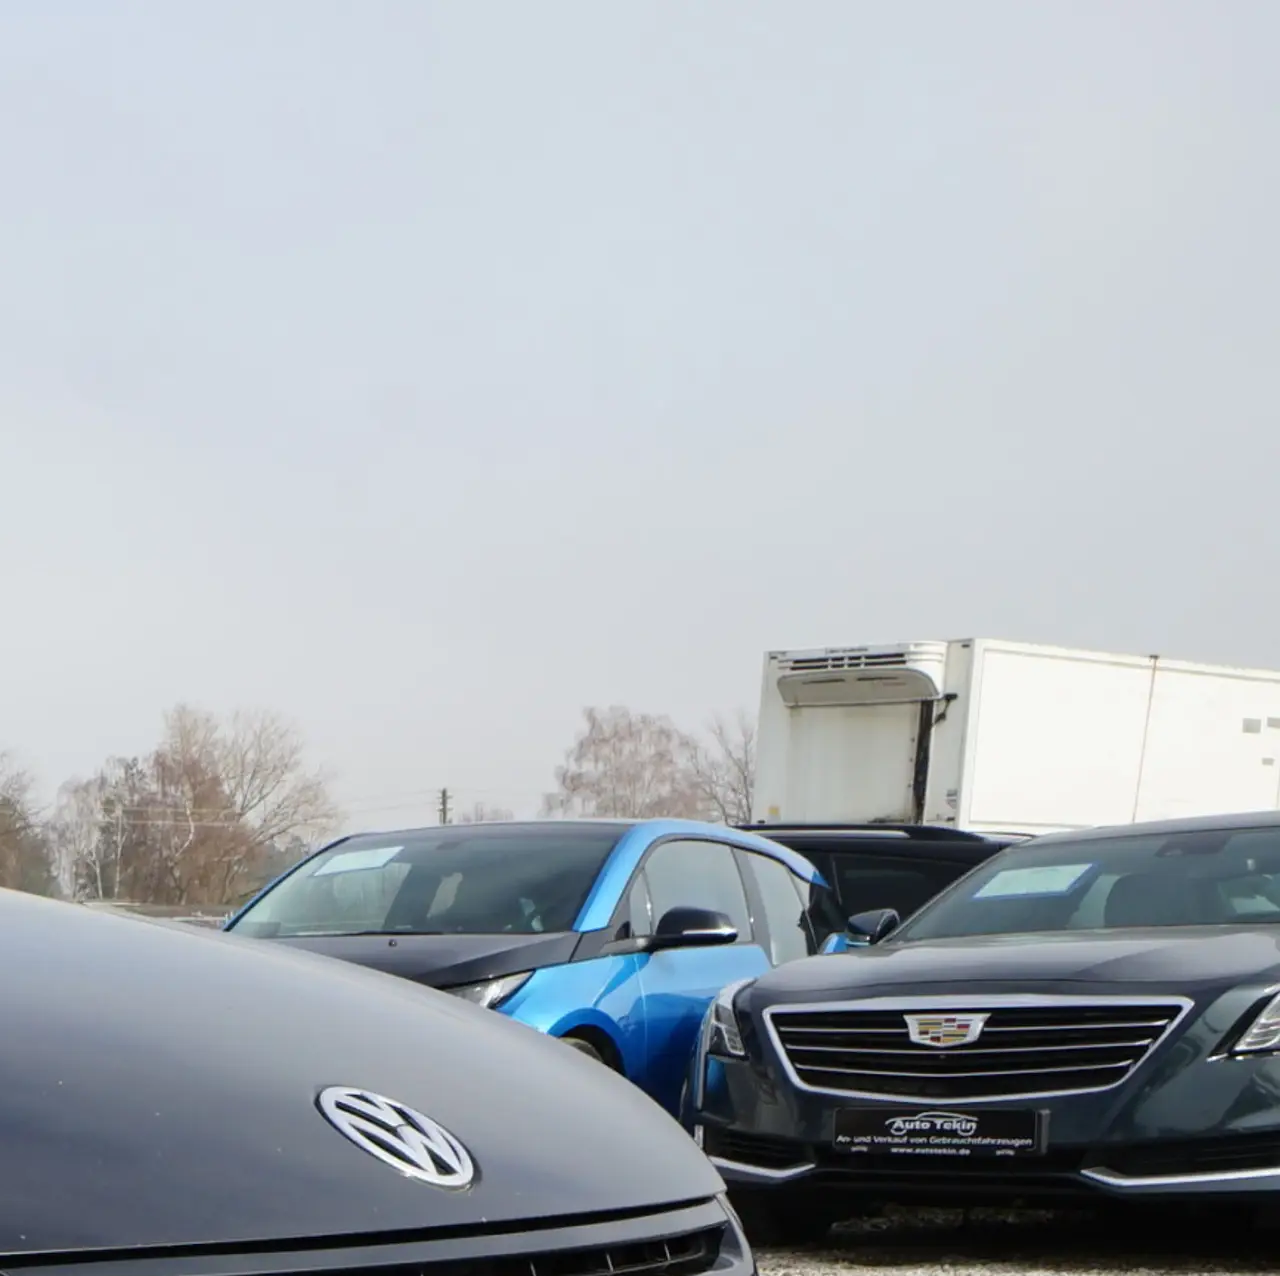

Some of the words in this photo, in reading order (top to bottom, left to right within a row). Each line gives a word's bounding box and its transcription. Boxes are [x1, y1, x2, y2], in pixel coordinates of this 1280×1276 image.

[893, 1118, 930, 1131] Auto
[936, 1118, 977, 1132] Tekin
[853, 1134, 872, 1144] und
[874, 1134, 908, 1145] Verkauf
[910, 1136, 927, 1145] von
